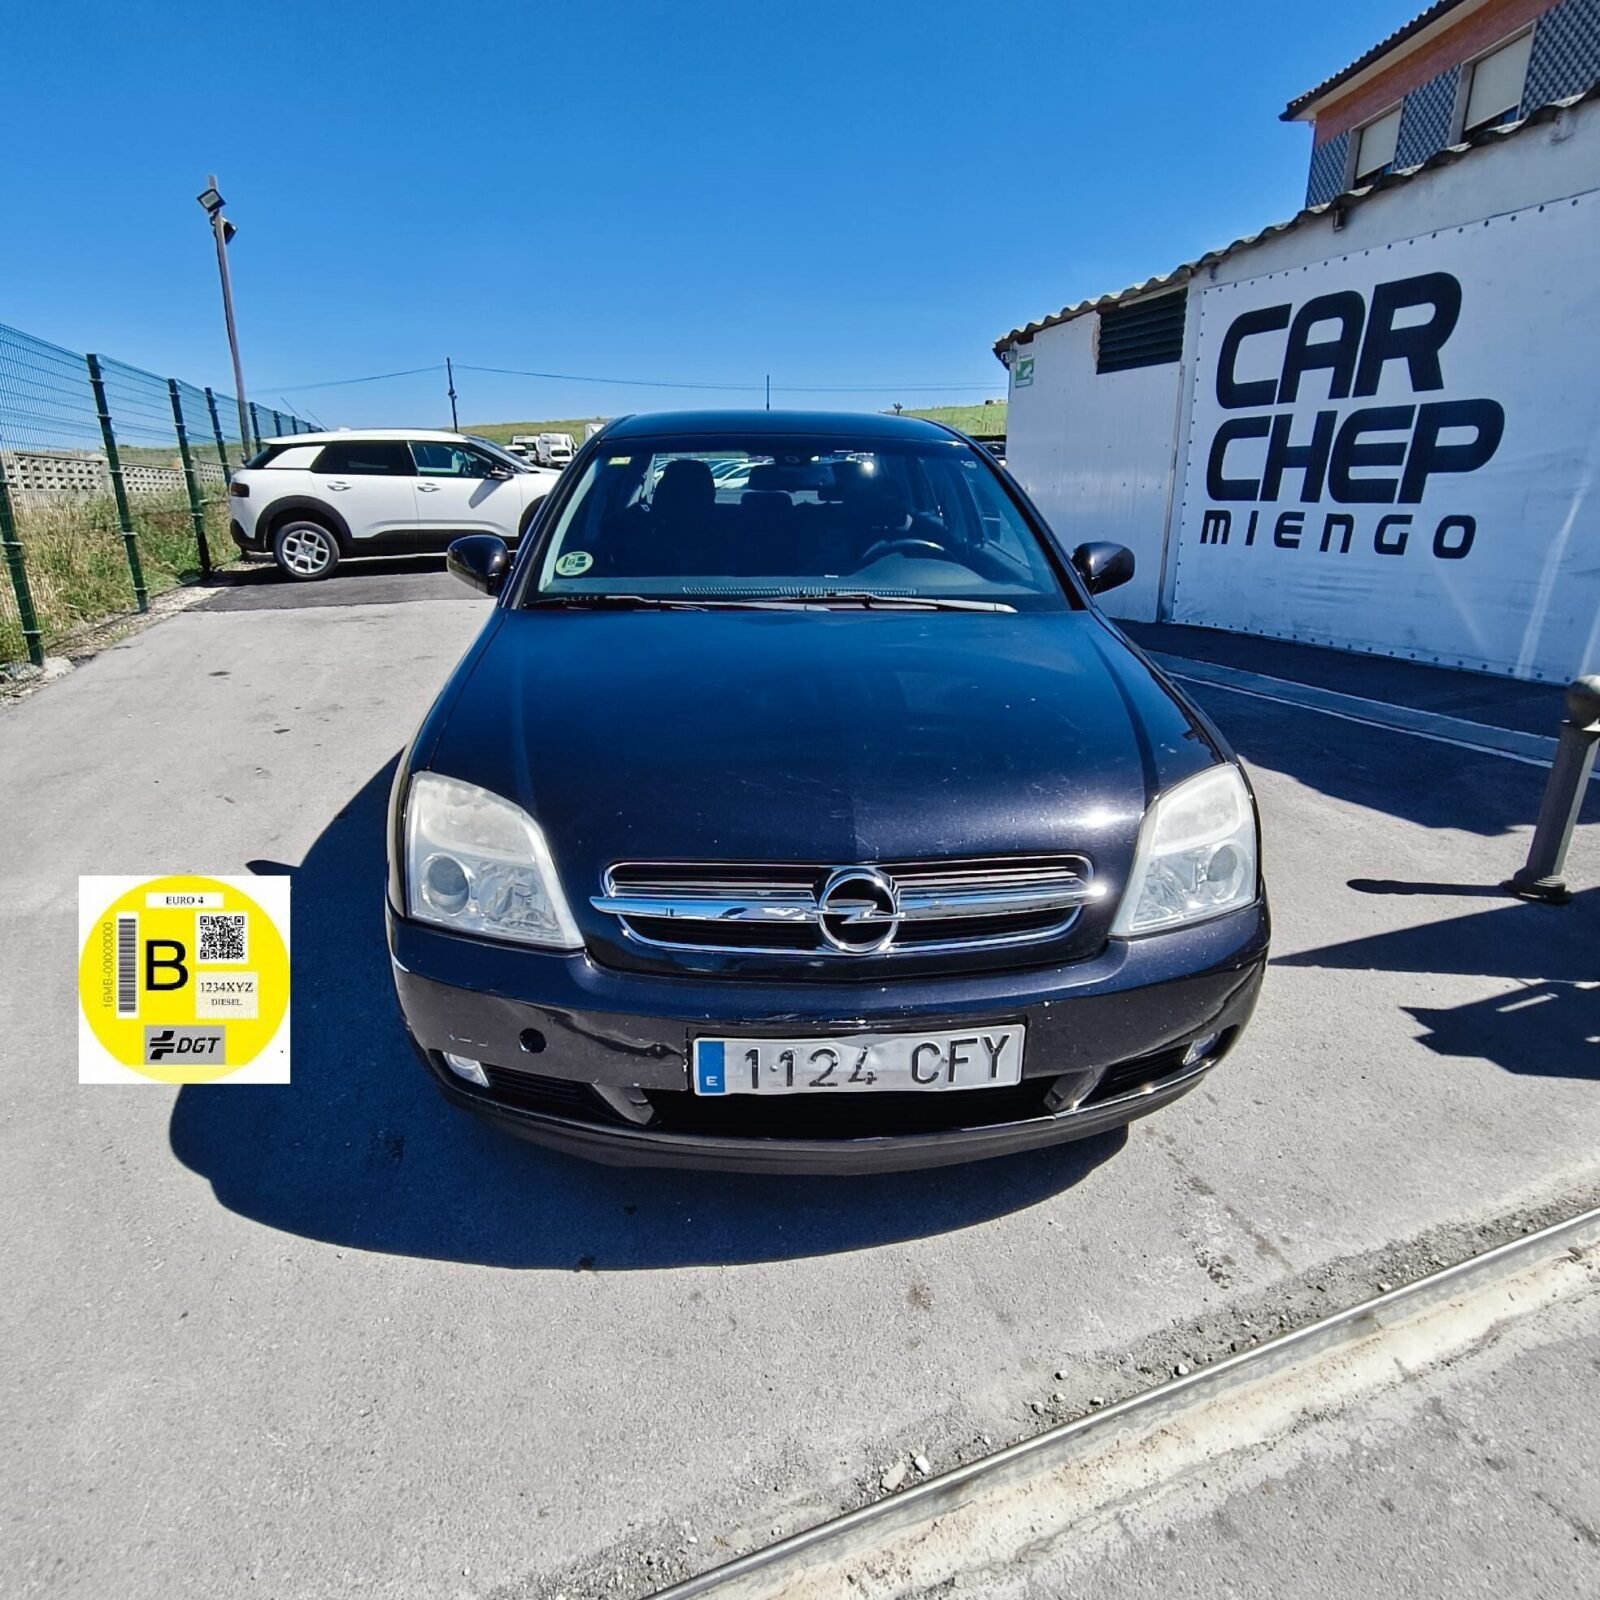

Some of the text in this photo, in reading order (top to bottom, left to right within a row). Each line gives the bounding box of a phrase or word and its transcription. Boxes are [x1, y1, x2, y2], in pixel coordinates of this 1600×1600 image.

[1216, 272, 1462, 409] CAR
[1206, 398, 1505, 504] CHEP
[706, 1076, 718, 1087] E
[743, 1034, 1011, 1090] 1124 CFY
